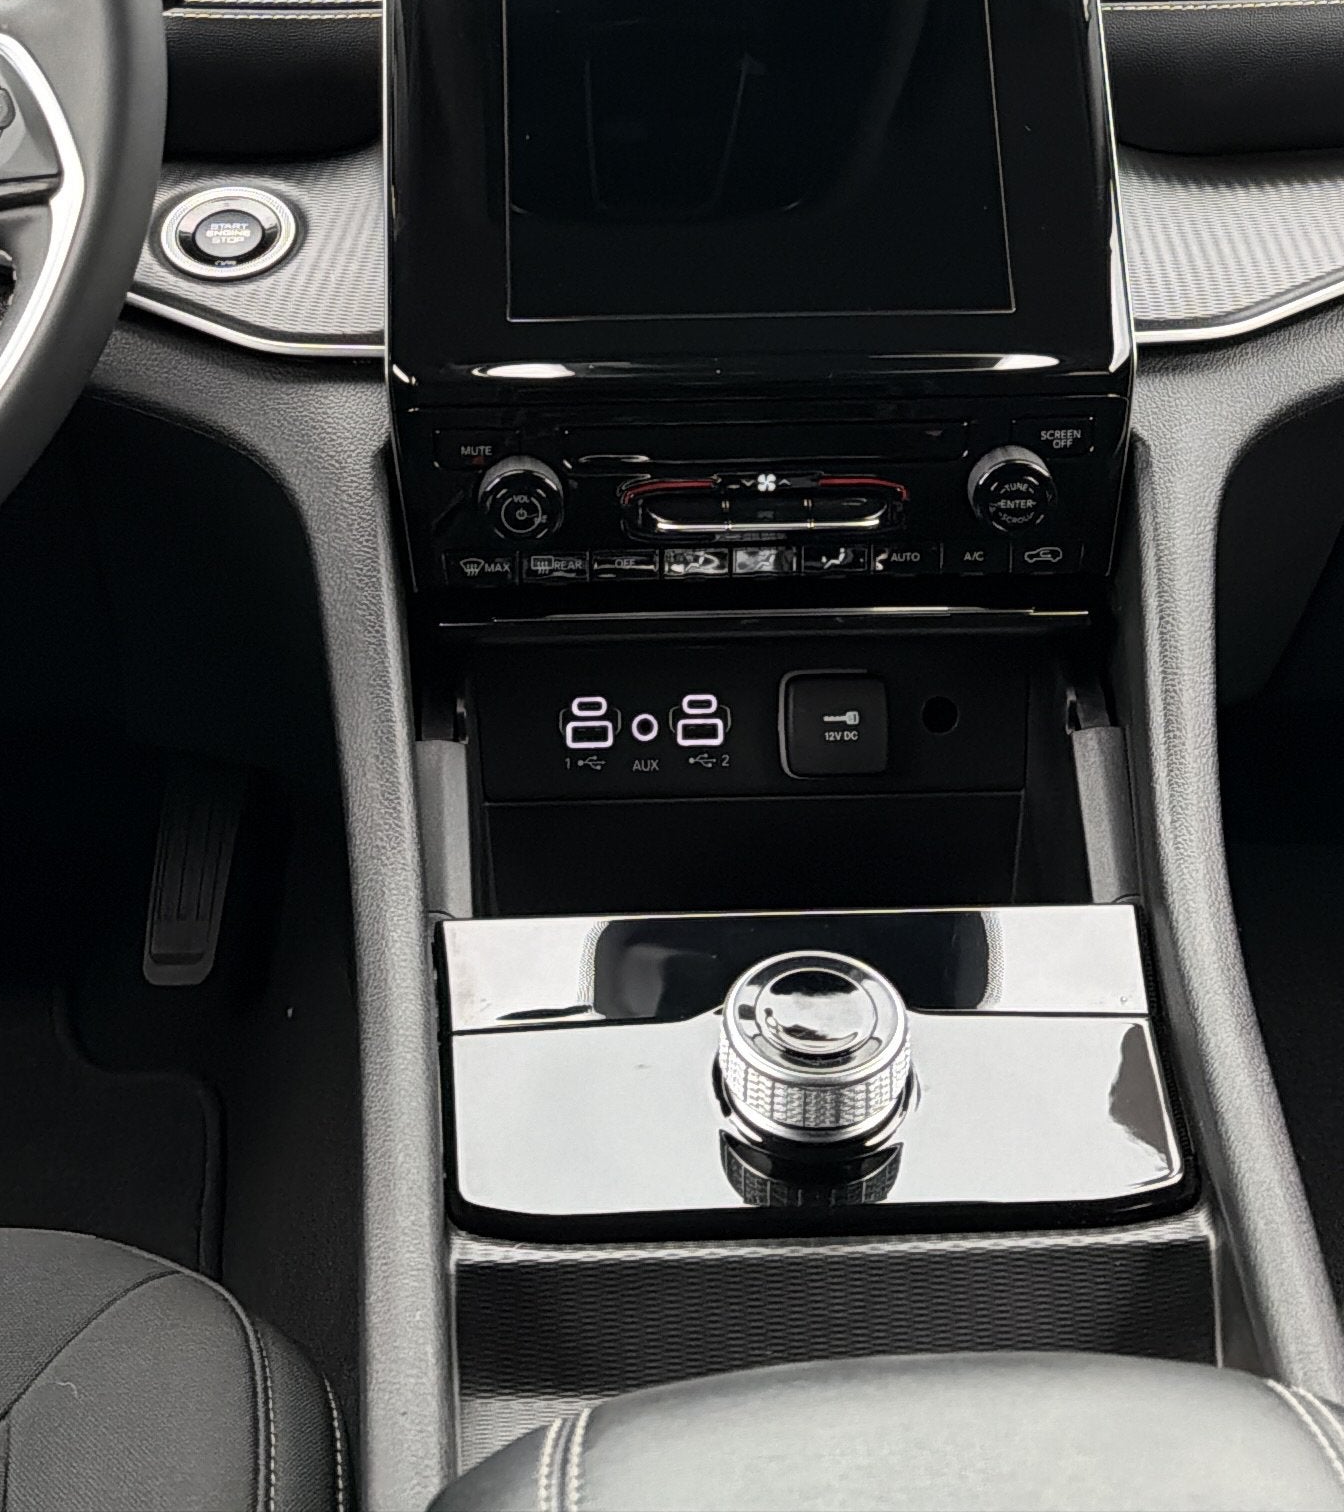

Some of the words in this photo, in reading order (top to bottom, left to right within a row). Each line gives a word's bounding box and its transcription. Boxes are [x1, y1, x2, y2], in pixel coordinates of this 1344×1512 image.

[1040, 429, 1082, 441] SCREEN
[1052, 439, 1073, 448] OFF
[460, 446, 493, 456] MUTE
[512, 494, 531, 504] VOL
[1000, 499, 1034, 509] ENTER
[890, 552, 921, 562] AUTO
[963, 551, 985, 561] A/C
[484, 563, 511, 573] MAX
[554, 559, 583, 570] REAR
[614, 558, 636, 568] OFF
[824, 731, 842, 741] 12V
[843, 730, 859, 741] DC
[632, 759, 660, 772] AUX
[721, 755, 730, 767] 2
